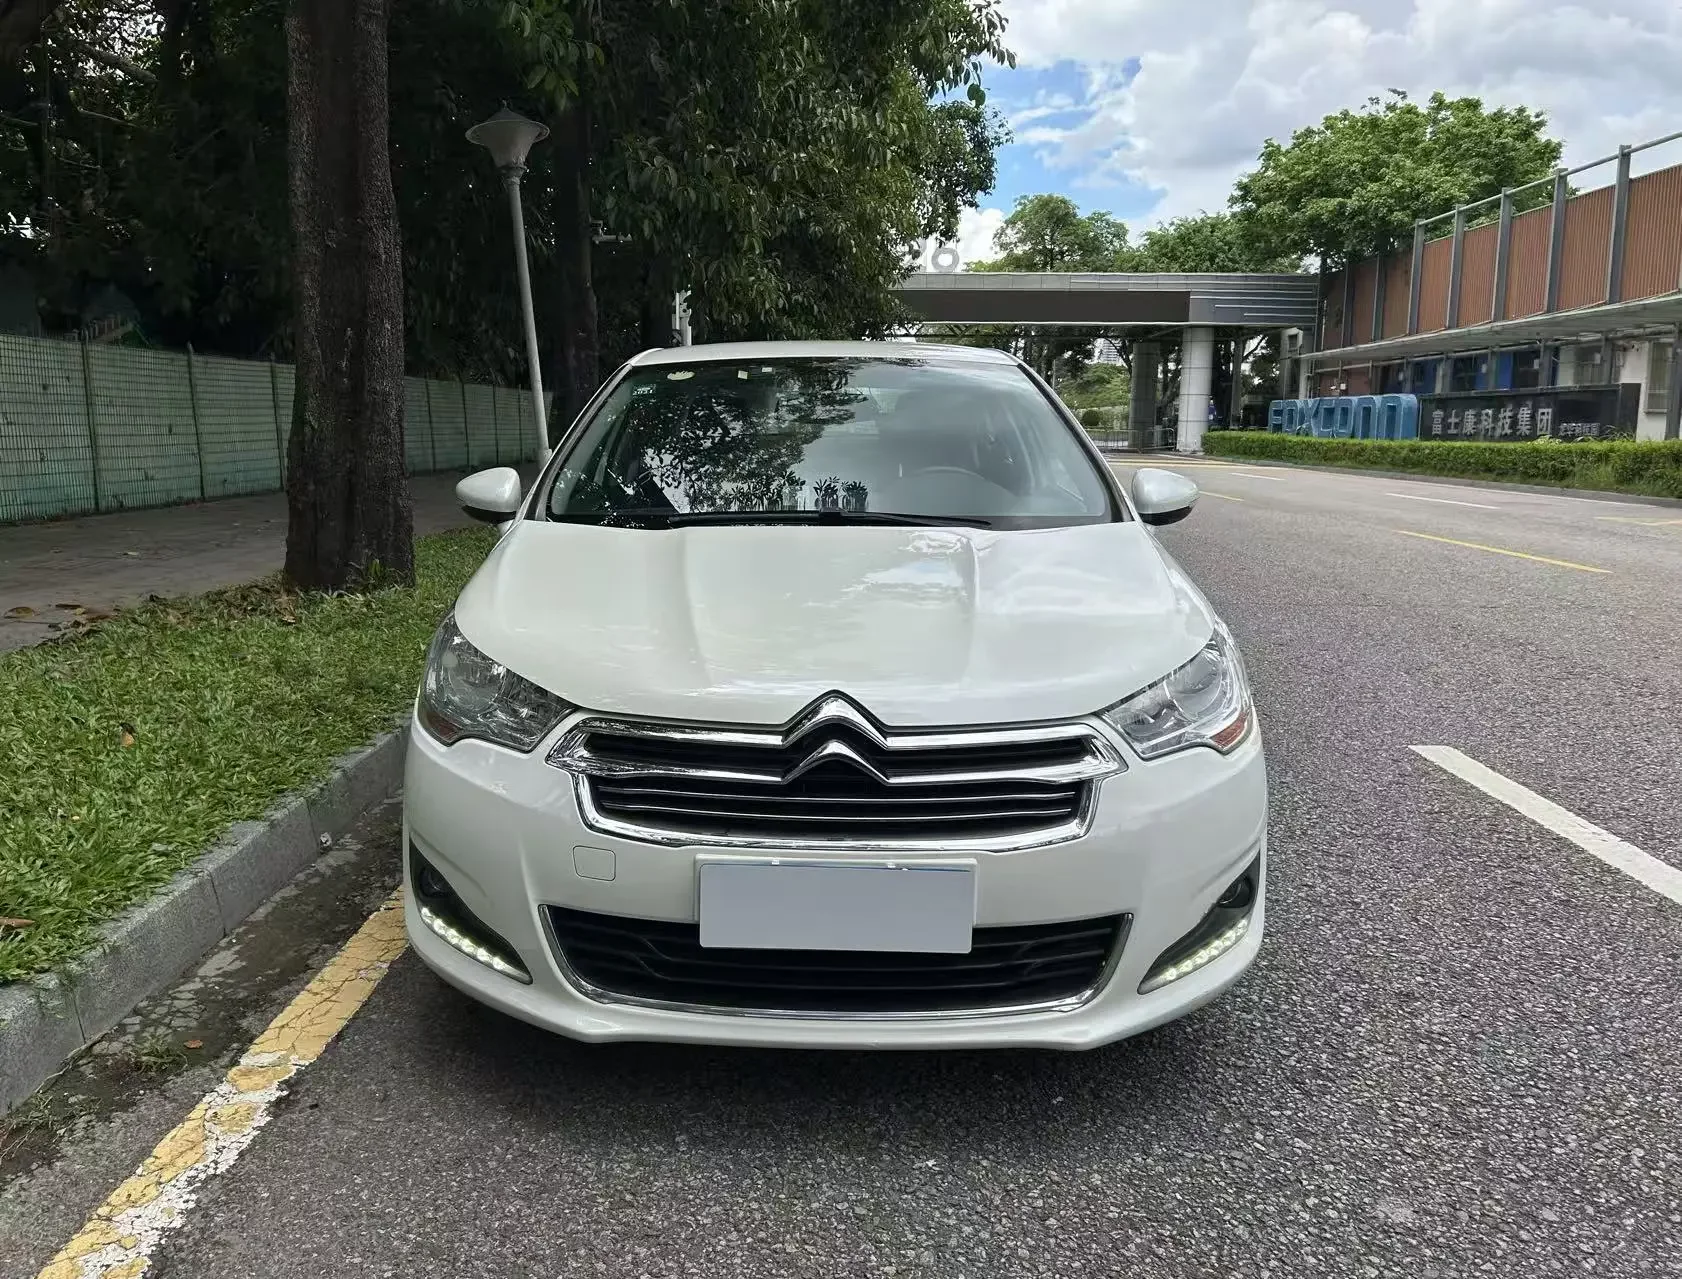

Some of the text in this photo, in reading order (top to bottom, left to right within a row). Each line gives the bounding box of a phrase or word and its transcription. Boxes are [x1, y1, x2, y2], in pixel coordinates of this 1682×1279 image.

[1431, 406, 1553, 437] 富士康科技集团
